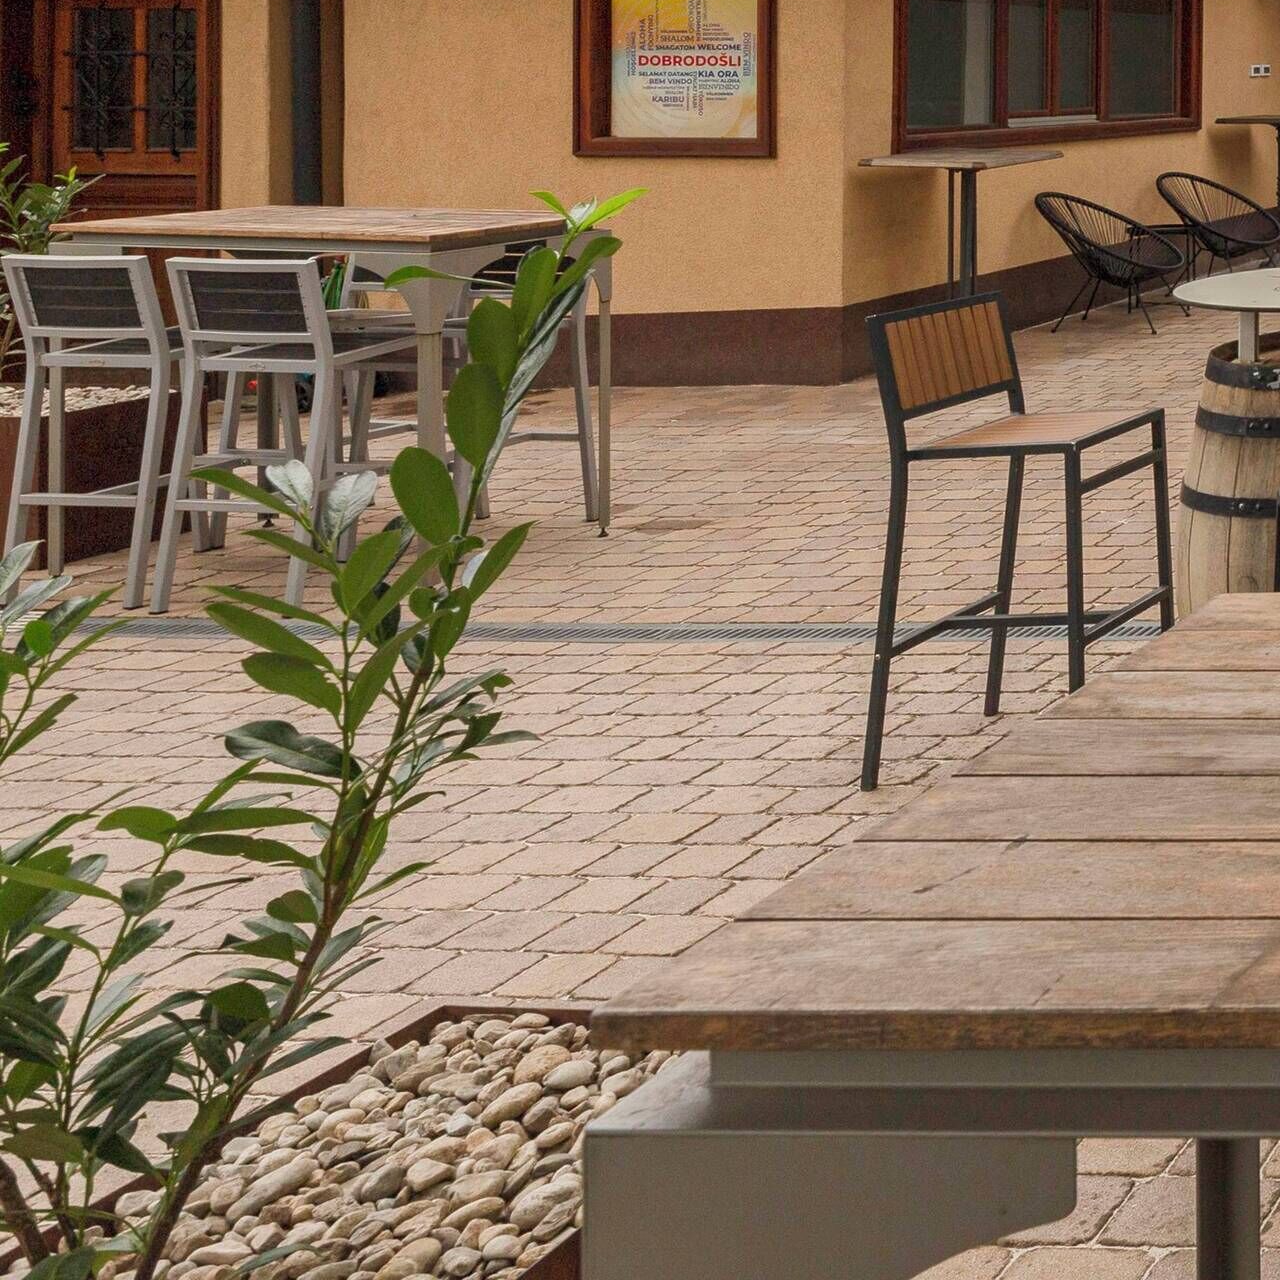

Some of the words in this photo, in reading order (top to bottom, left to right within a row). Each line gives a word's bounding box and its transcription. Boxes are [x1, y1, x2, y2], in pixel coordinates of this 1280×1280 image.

[638, 52, 741, 67] DOBRODOŠLI
[698, 70, 715, 78] KIA
[718, 70, 739, 78] ORA
